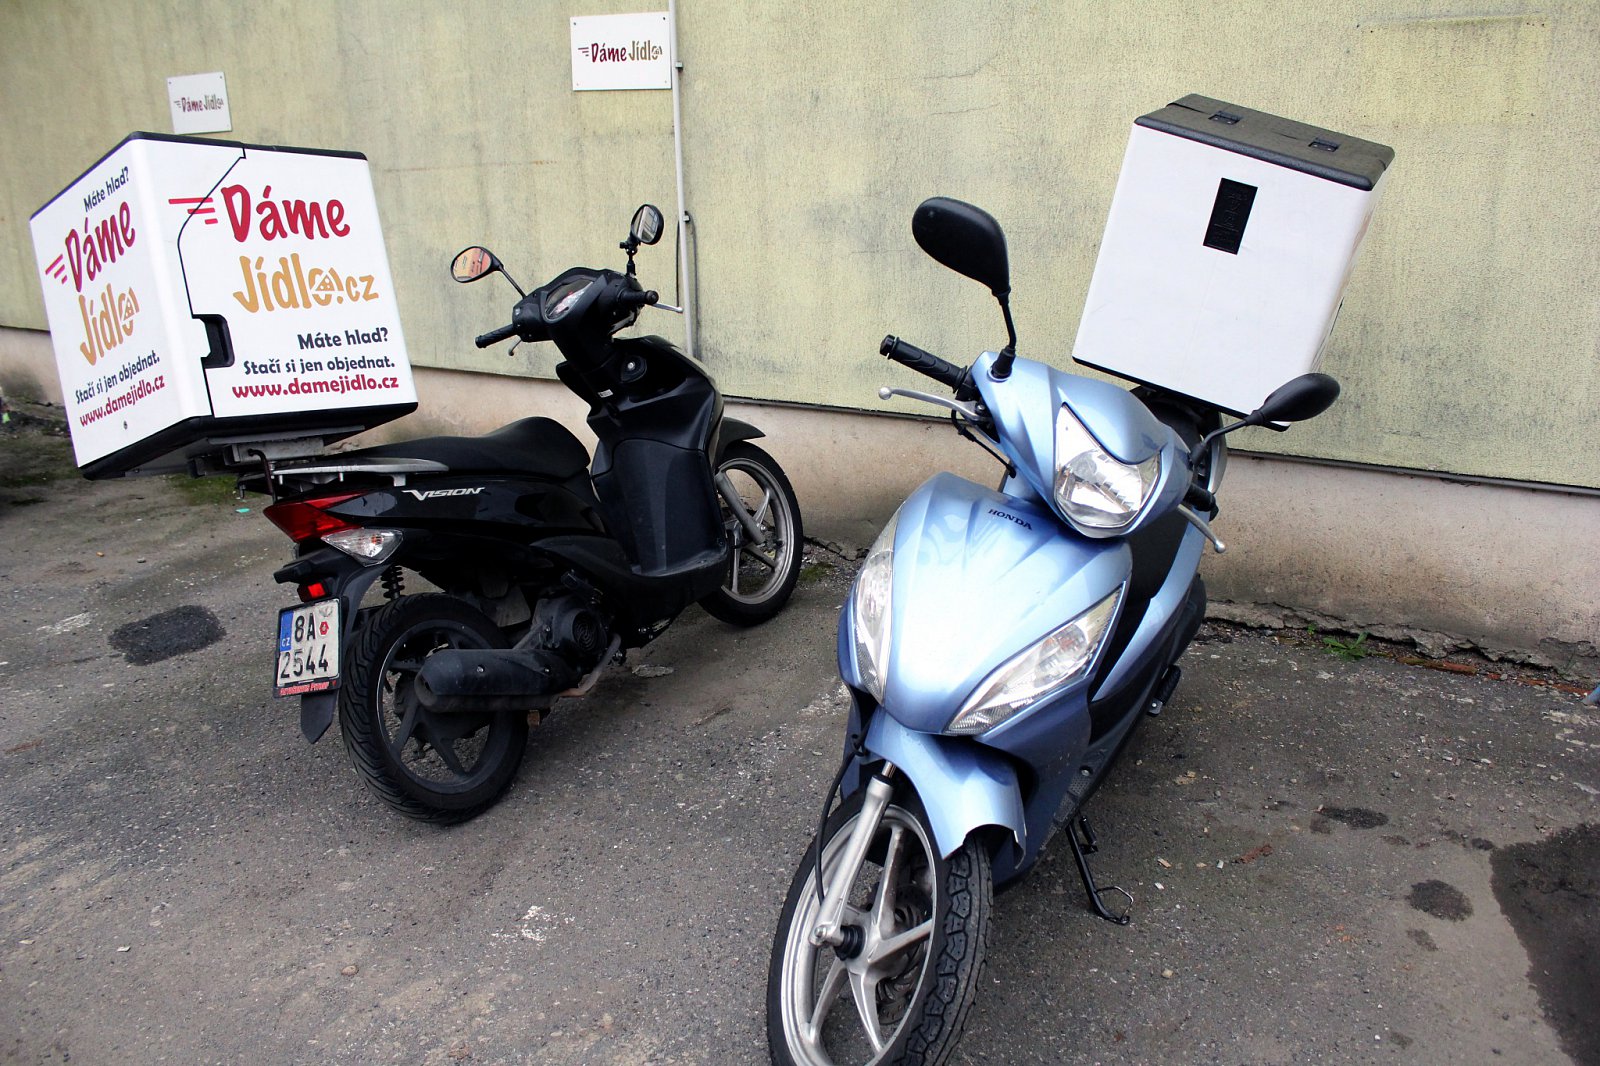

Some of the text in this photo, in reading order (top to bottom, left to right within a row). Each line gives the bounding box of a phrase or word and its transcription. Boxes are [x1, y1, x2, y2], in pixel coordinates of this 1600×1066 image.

[591, 39, 663, 63] Dáme Jídlo
[181, 97, 203, 113] Dáme
[83, 166, 129, 212] Máte hlad?
[220, 184, 350, 243] Dáme
[65, 201, 136, 293] Dáme
[233, 253, 379, 313] Jídlo.cz
[79, 282, 140, 366] Jídlo
[297, 326, 388, 350] Máte hlad?
[75, 350, 160, 405] Stačí si jen objednat.
[243, 355, 395, 375] Stačí si jen objednat.
[80, 375, 165, 427] www.damejidlo.cz
[232, 374, 399, 398] www.damejidlo.cz
[401, 487, 486, 501] VISION
[988, 508, 1033, 531] HONDA
[281, 637, 291, 647] CZ
[294, 612, 316, 642] 8A
[280, 643, 329, 679] 2544
